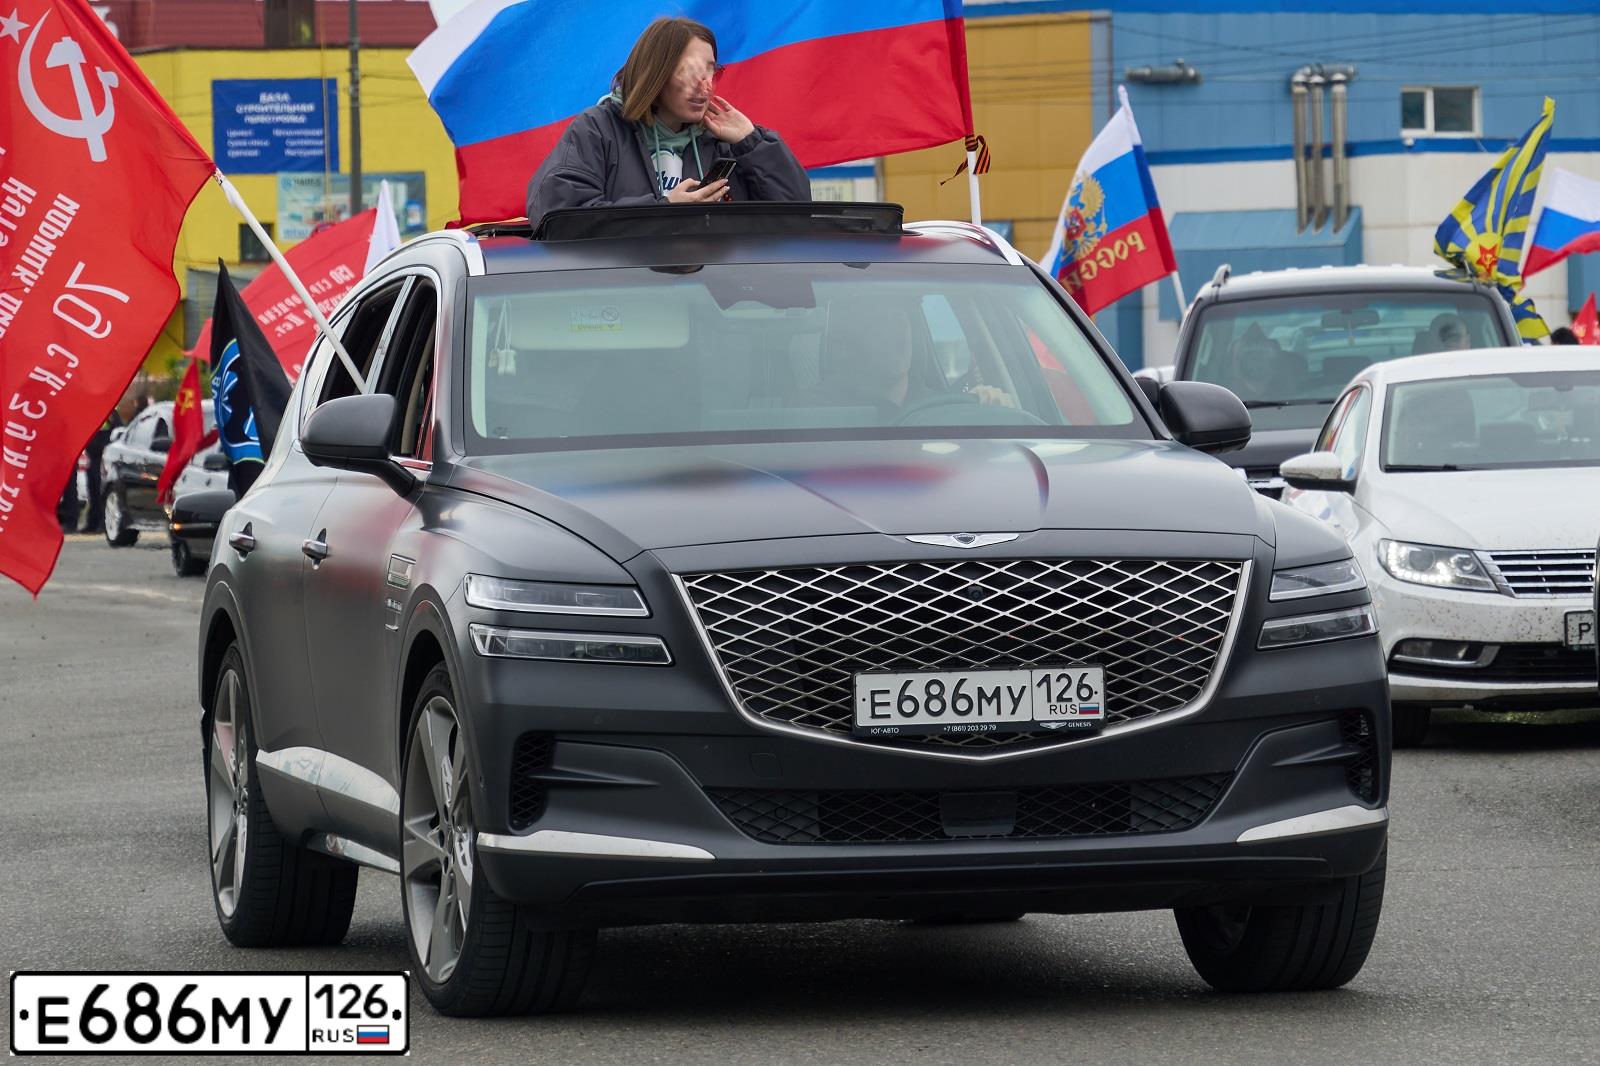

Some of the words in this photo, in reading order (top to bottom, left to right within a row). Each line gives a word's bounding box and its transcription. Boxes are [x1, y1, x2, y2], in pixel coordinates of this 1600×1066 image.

[870, 678, 1027, 719] Е686МУ
[1036, 672, 1093, 703] 126
[1050, 703, 1078, 715] RUS
